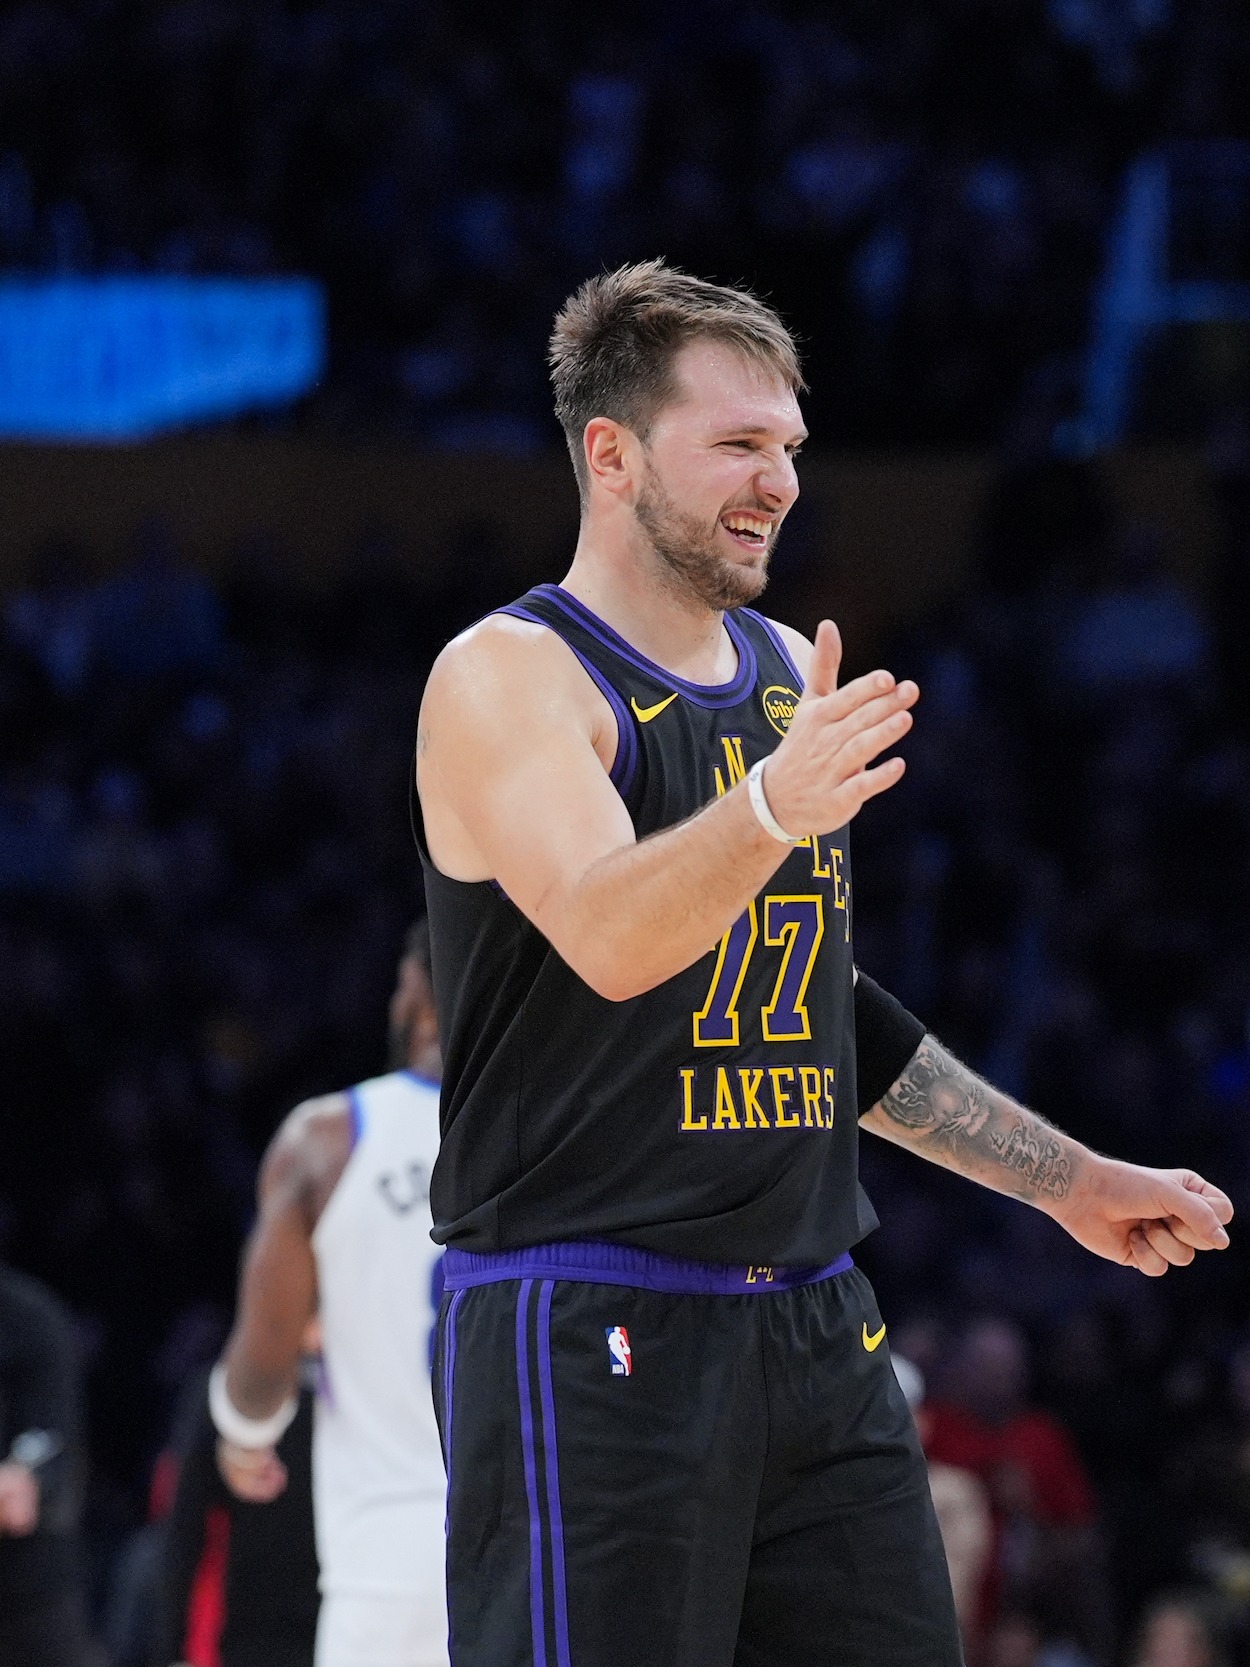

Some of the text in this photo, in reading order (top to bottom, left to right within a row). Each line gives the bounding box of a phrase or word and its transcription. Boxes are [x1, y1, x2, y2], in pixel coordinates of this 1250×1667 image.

[766, 699, 800, 719] bibi
[693, 894, 824, 1047] 77
[679, 1065, 835, 1132] LAKERS
